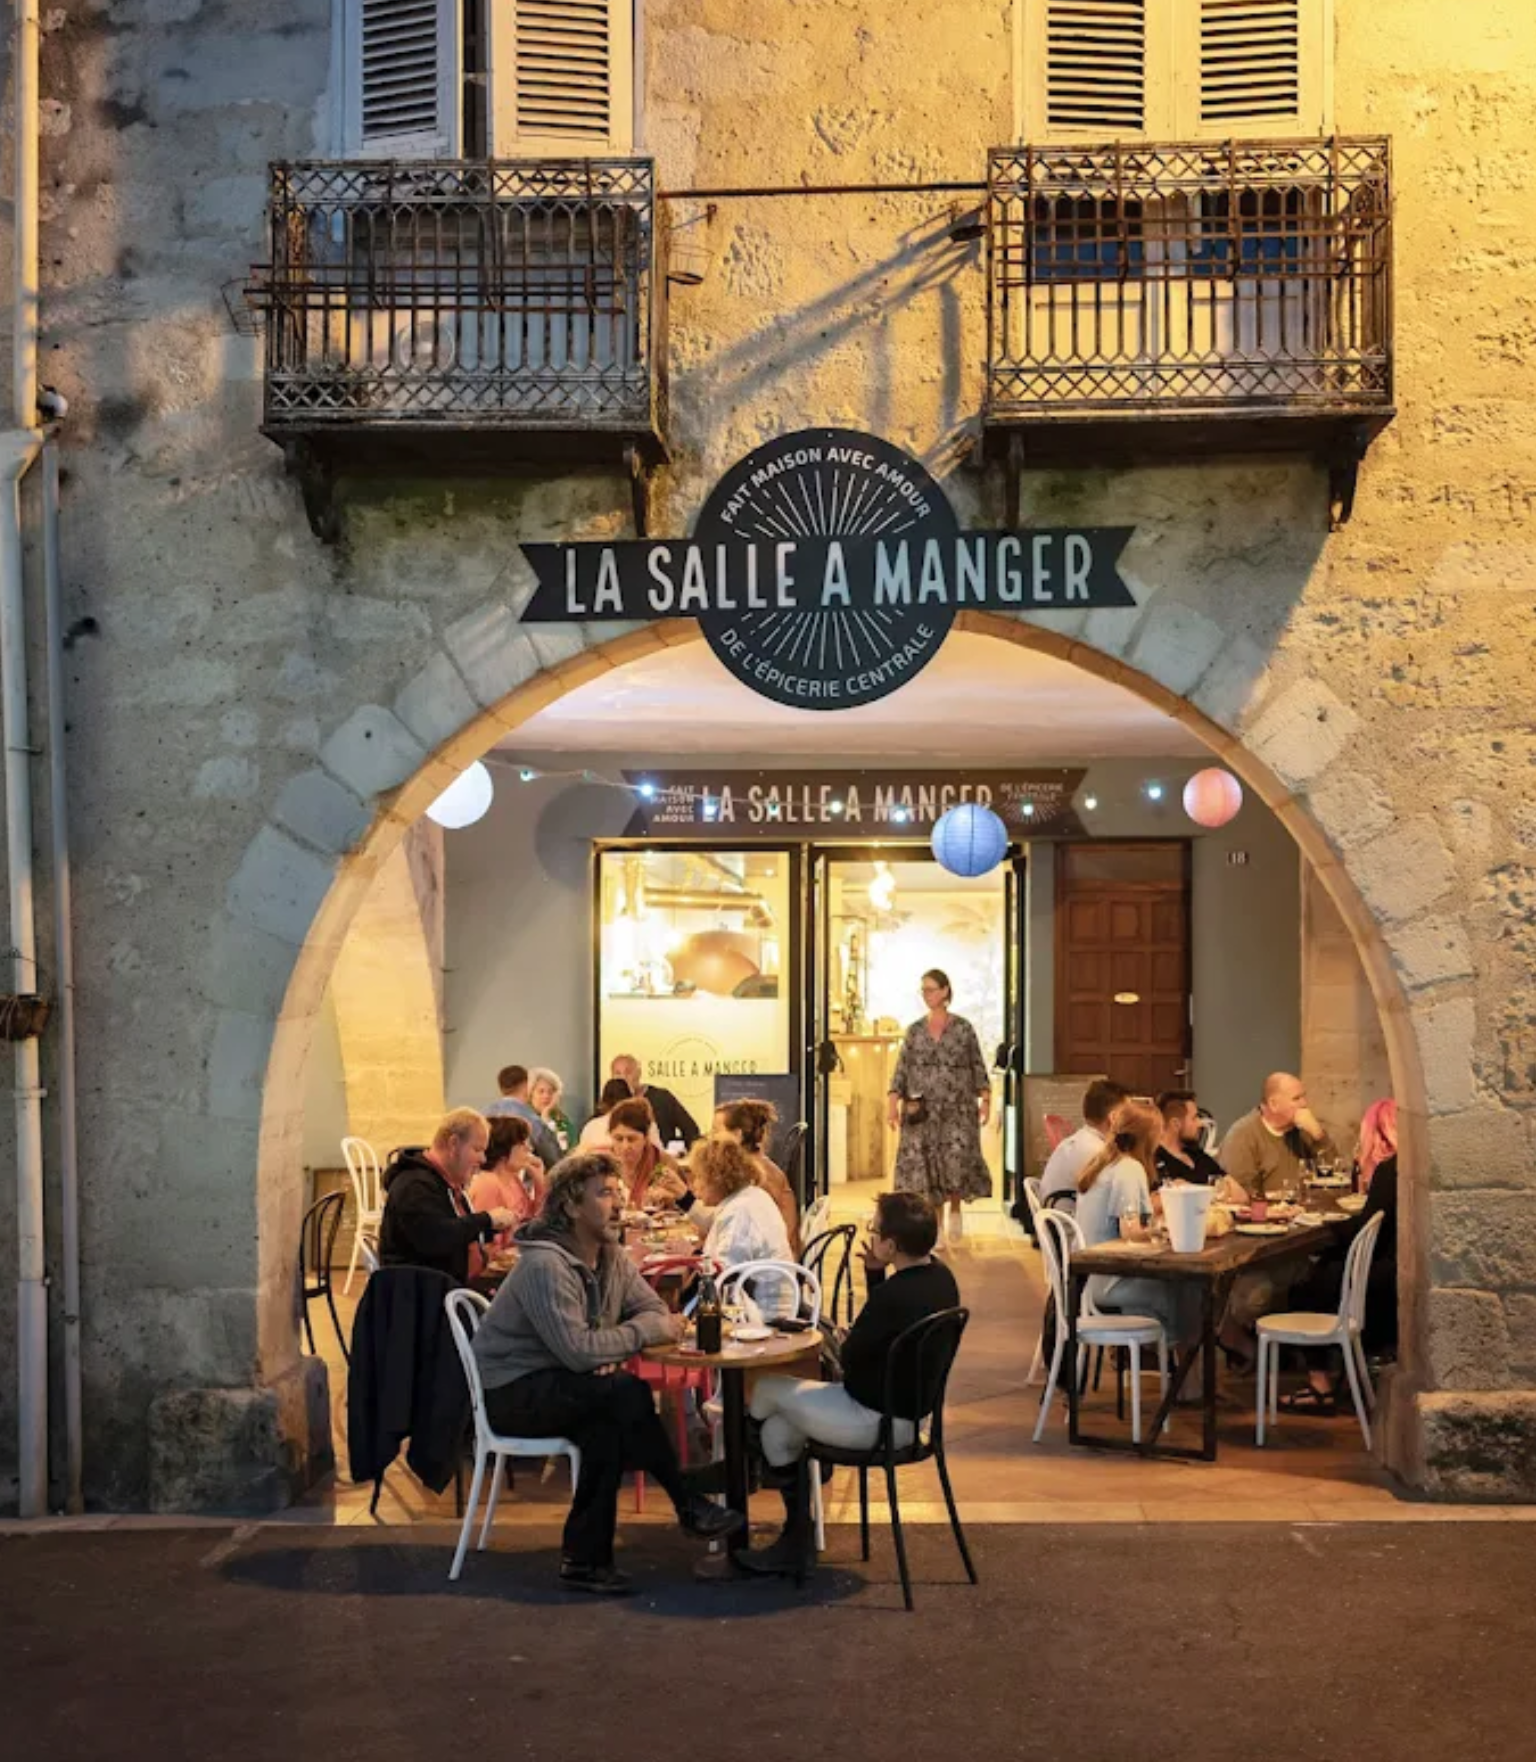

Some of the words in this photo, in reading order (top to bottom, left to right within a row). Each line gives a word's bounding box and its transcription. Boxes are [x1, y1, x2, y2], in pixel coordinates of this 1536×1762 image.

[720, 483, 751, 524] FAIT
[750, 448, 821, 488] MAISON
[827, 447, 875, 470] AVEC
[874, 462, 931, 518] AMOUR
[565, 546, 624, 614] LA
[647, 540, 798, 612] SALLE
[821, 541, 852, 607] A
[873, 534, 1093, 606] MANGER
[720, 627, 747, 657] DE
[741, 652, 841, 697] L'ÉPICERIE
[846, 622, 935, 695] CENTRALE
[653, 814, 695, 823] AMOUR
[665, 804, 695, 814] AVEC
[702, 785, 735, 822] LA
[748, 785, 832, 822] SALLE
[844, 785, 862, 822] A
[648, 1060, 686, 1077] SALLE
[691, 1060, 699, 1077] A
